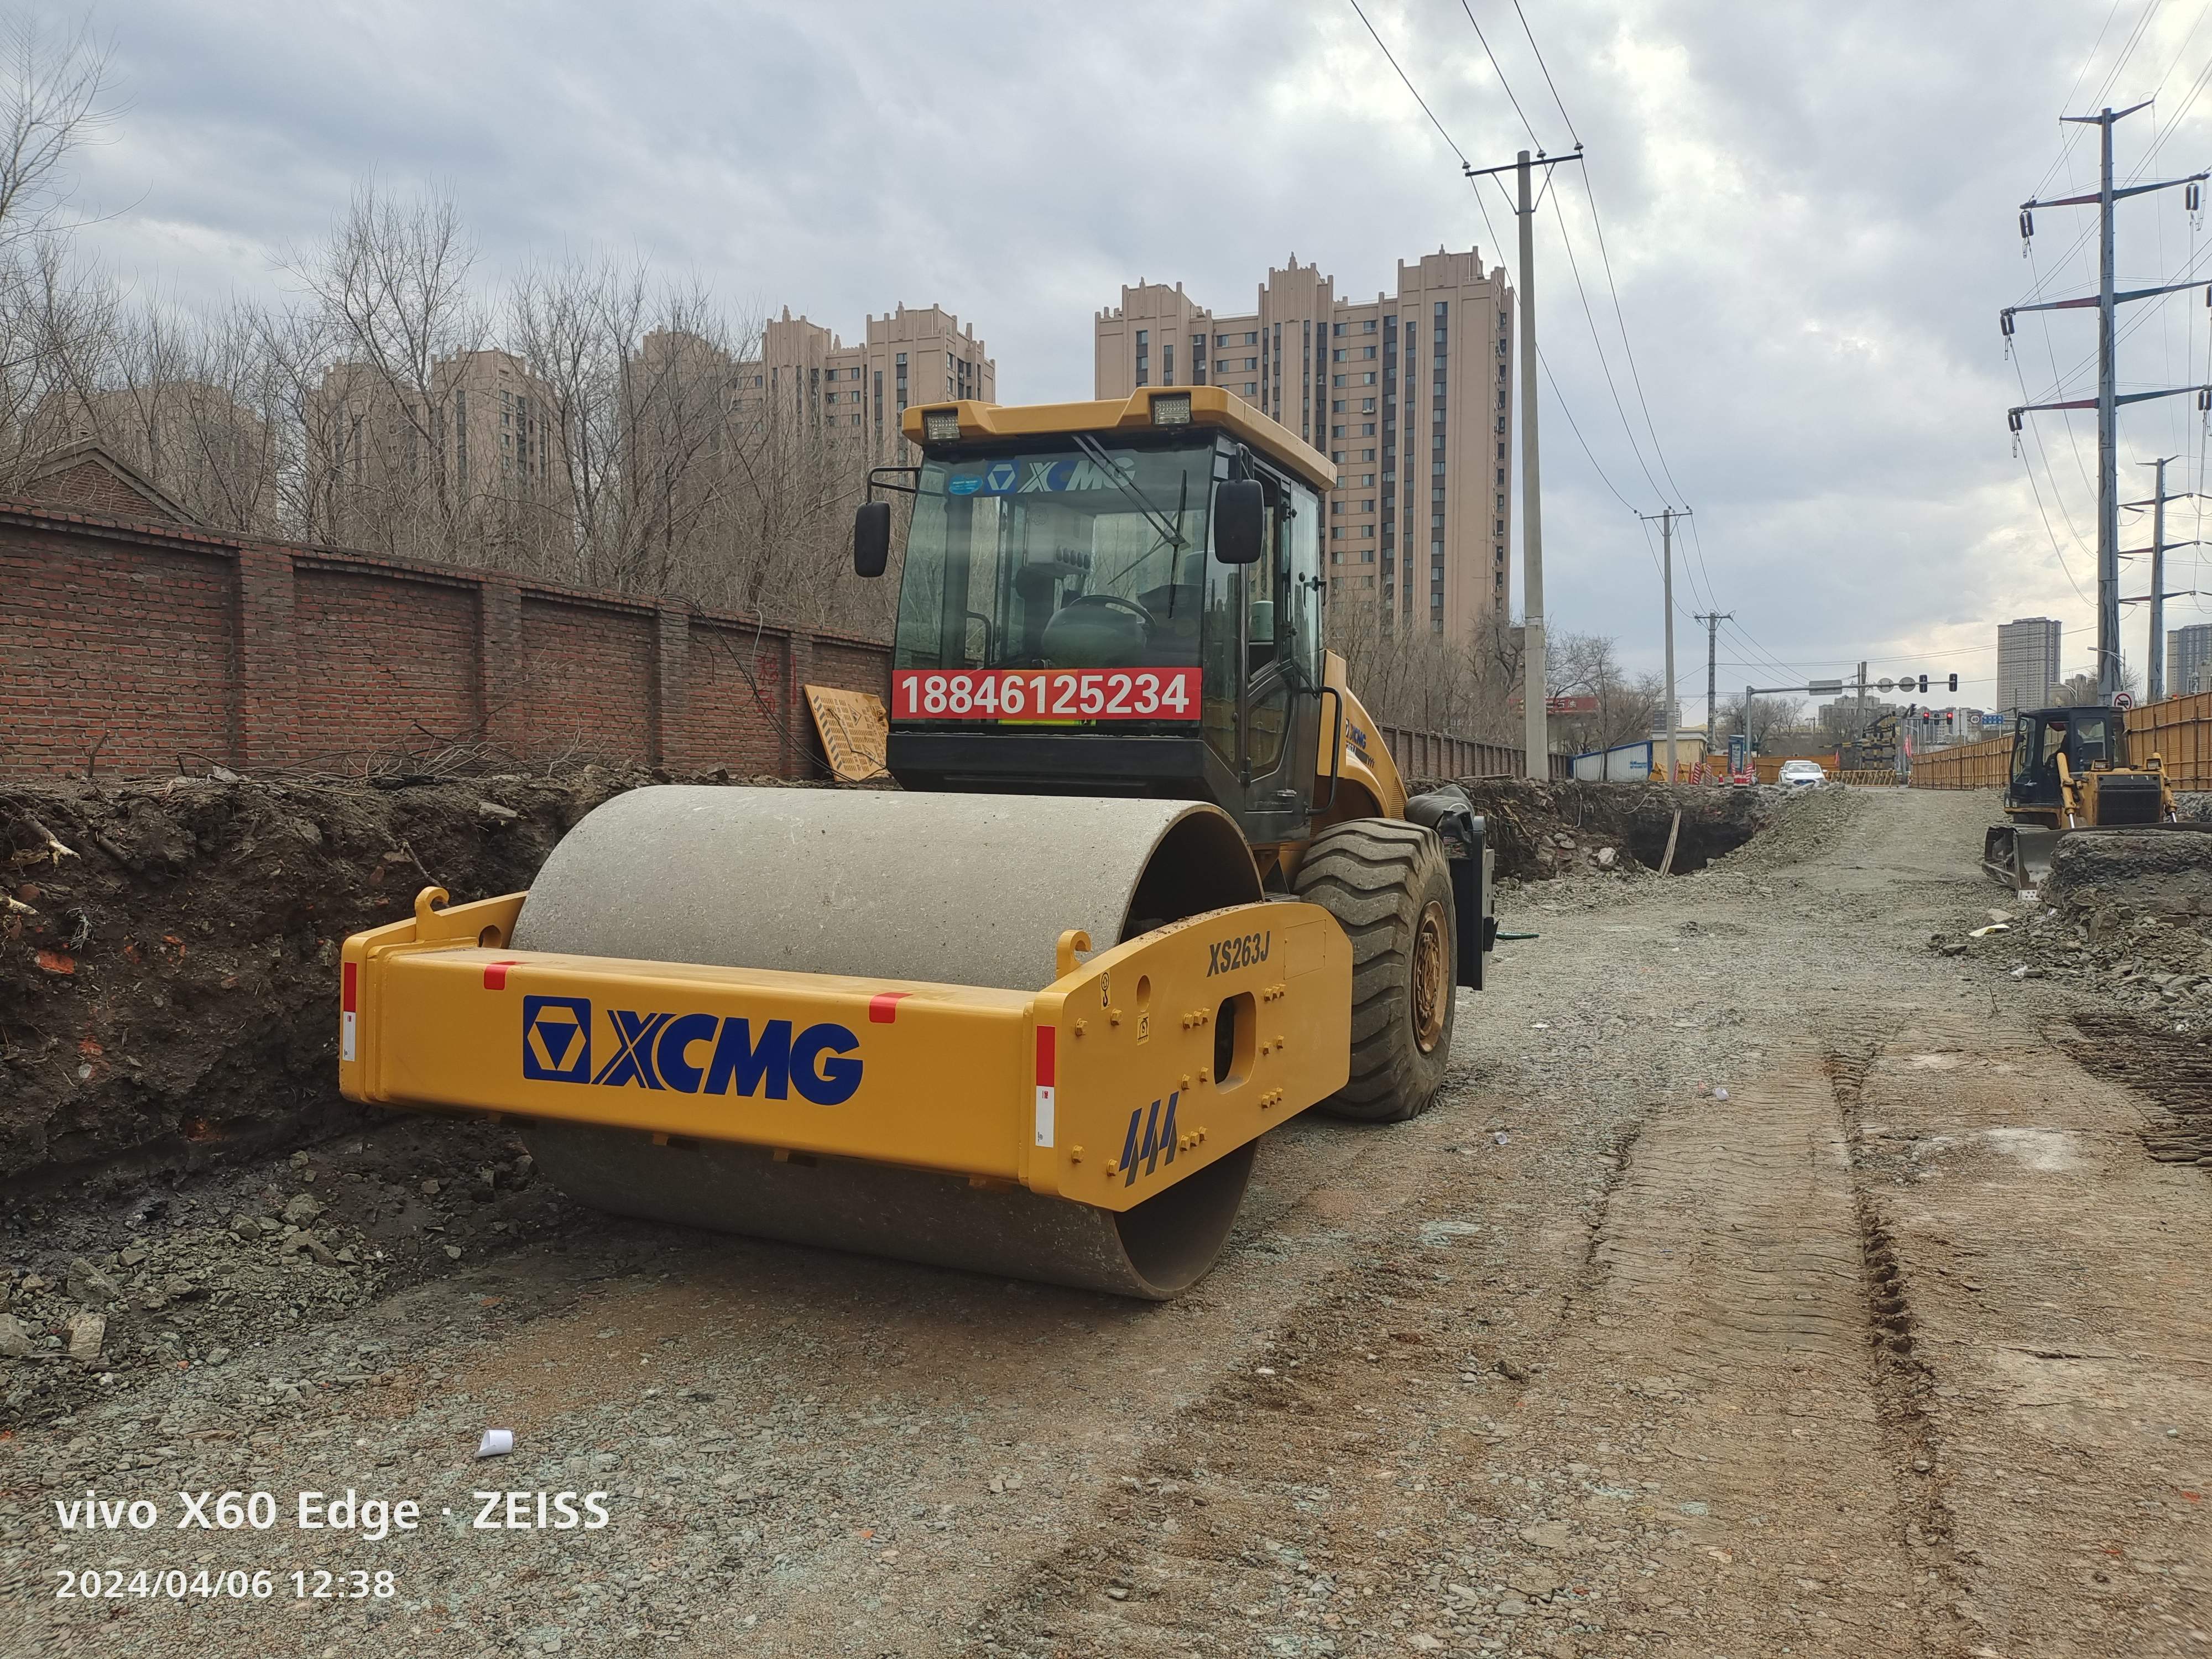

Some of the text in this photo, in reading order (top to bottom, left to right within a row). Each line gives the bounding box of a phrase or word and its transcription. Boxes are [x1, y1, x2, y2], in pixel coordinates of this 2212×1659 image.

[1018, 457, 1135, 493] XCMG
[902, 674, 1190, 714] 18846125234
[1206, 931, 1270, 978] XS263J
[591, 1009, 864, 1106] XCMG
